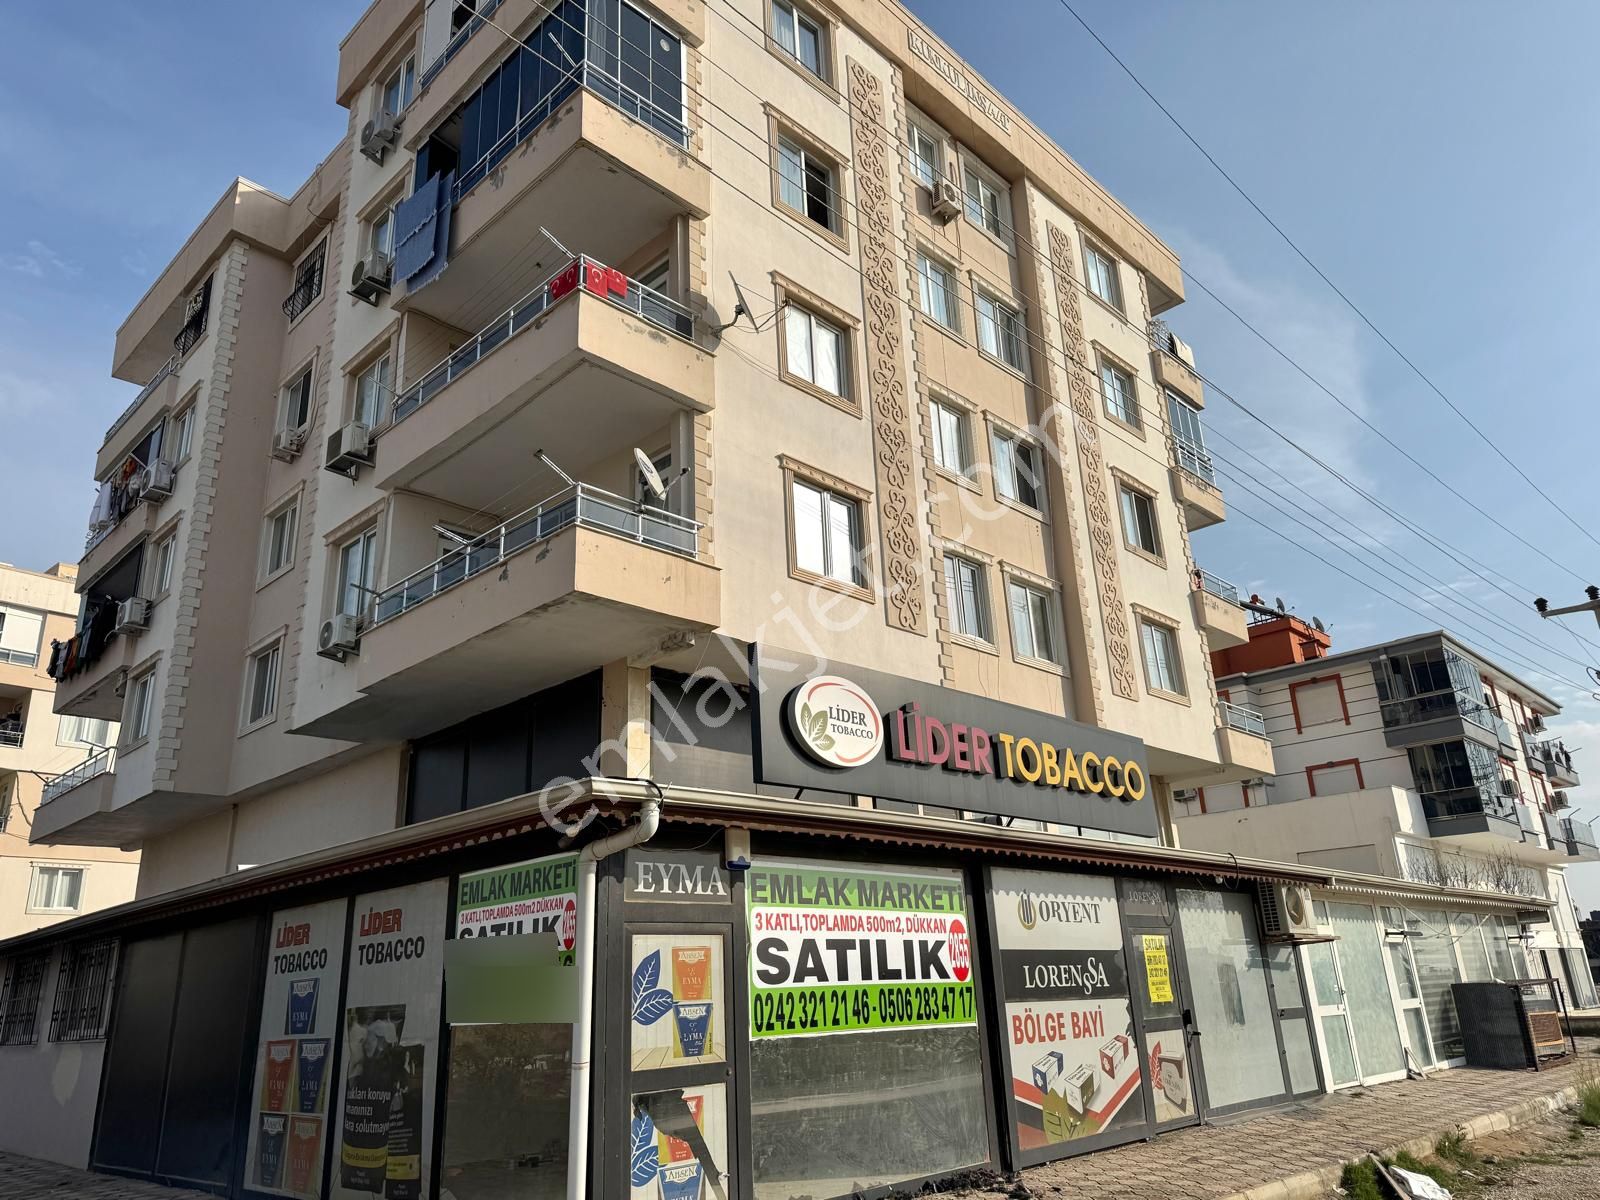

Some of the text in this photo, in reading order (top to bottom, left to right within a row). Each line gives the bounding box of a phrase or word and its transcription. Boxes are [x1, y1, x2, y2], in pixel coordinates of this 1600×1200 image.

[828, 703, 868, 728] LİDER
[830, 723, 874, 741] TOBACCO
[895, 701, 1146, 801] LİDER TOBACCO
[461, 859, 577, 906] EMLAK MARKETİ
[633, 861, 728, 896] EYMA
[750, 872, 965, 911] EMLAK MARKETİ
[359, 906, 403, 937] LİDER
[460, 913, 465, 925] 3
[536, 897, 564, 913] DÜKKAN
[755, 917, 763, 932] 3
[906, 913, 947, 934] DÜKKAN
[1039, 899, 1101, 924] ORYENT
[276, 921, 311, 949] LİDER
[358, 936, 425, 966] TOBACCO
[950, 932, 970, 969] 2855
[274, 948, 328, 975] TOBACCO
[756, 937, 951, 985] SATILIK
[1023, 957, 1110, 995] LORENSSA
[753, 992, 796, 1032] 0242
[799, 990, 827, 1029] 321
[831, 990, 849, 1026] 21
[852, 988, 870, 1024] 46
[879, 988, 912, 1023] 0506
[915, 987, 940, 1021] 283
[942, 986, 955, 1019] 47
[959, 986, 973, 1019] 17
[1012, 1005, 1105, 1045] BÖLGE BAYİ
